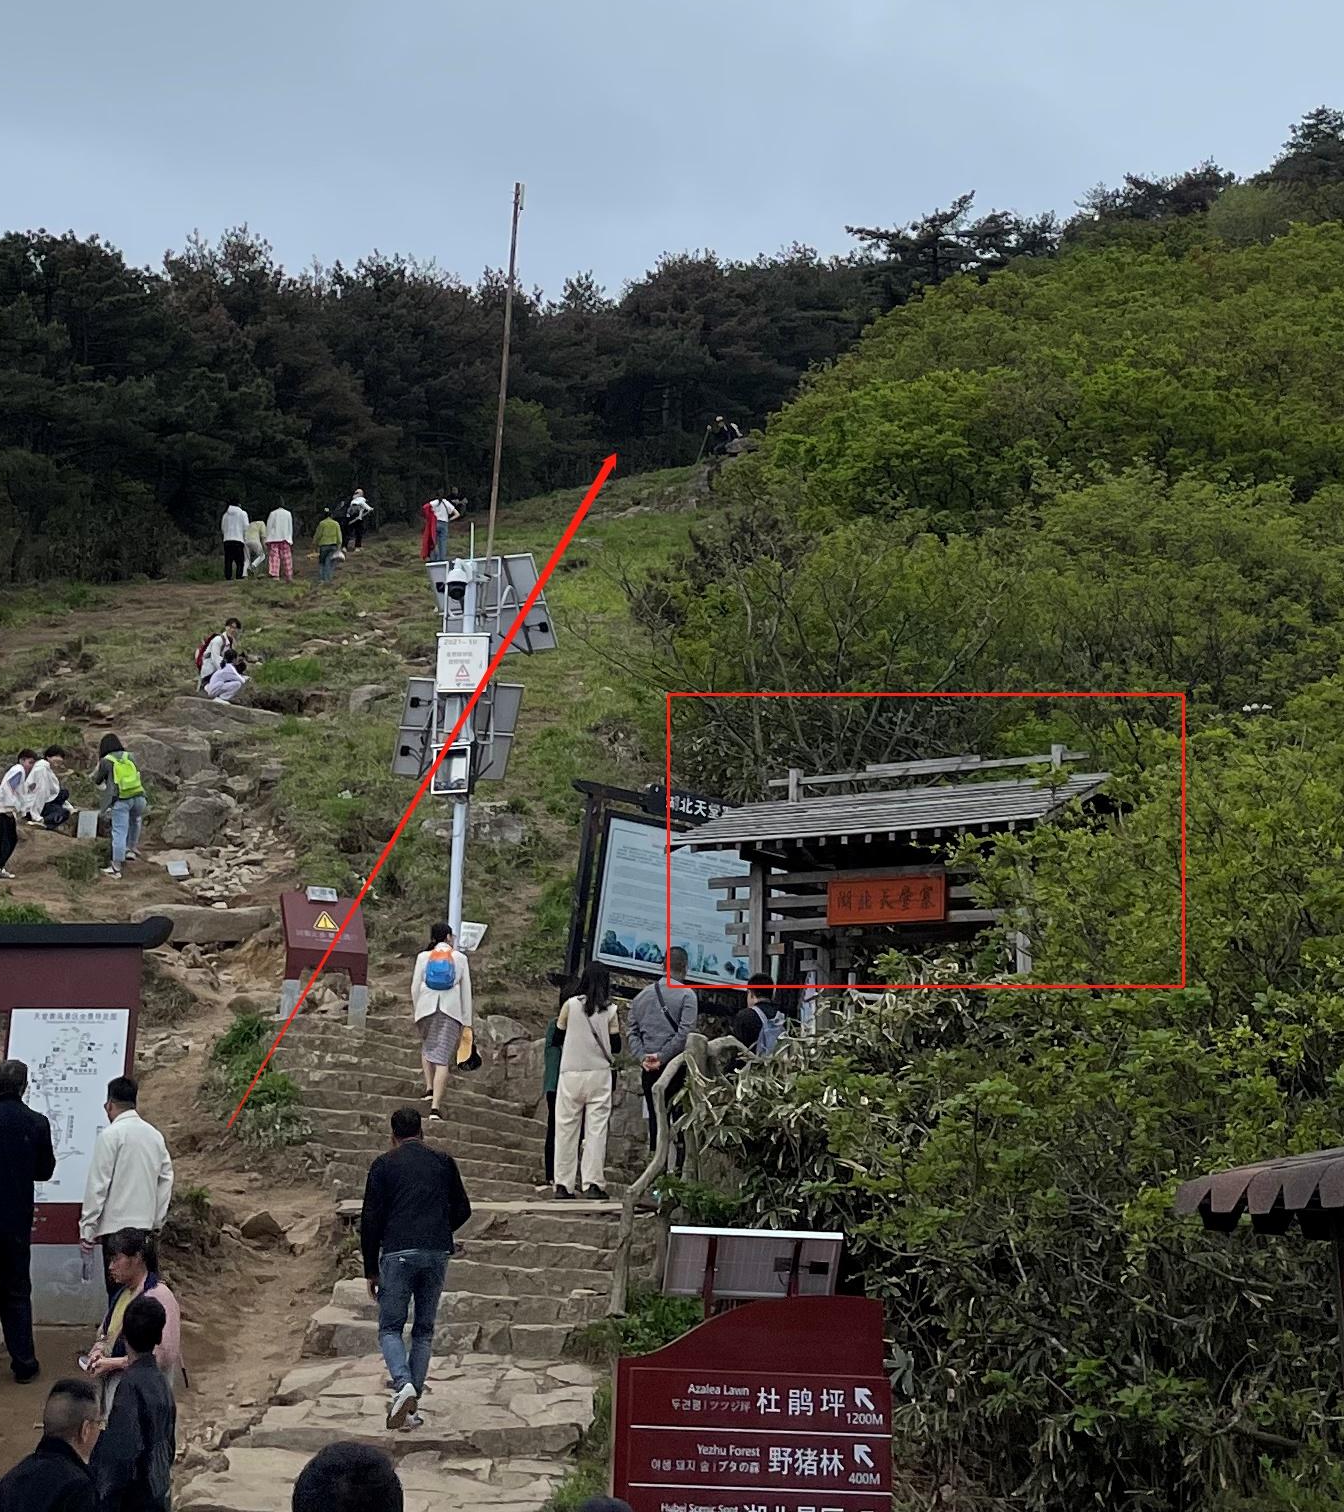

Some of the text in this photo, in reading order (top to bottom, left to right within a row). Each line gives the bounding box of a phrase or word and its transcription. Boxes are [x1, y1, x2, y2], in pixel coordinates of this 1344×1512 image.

[687, 1383, 750, 1397] Azalea Lawn
[756, 1386, 846, 1417] 杜鹃坪
[846, 1412, 884, 1426] 1200M
[697, 1443, 760, 1458] Yezhu Forest
[768, 1446, 844, 1477] 野猪林
[848, 1472, 881, 1485] 400M
